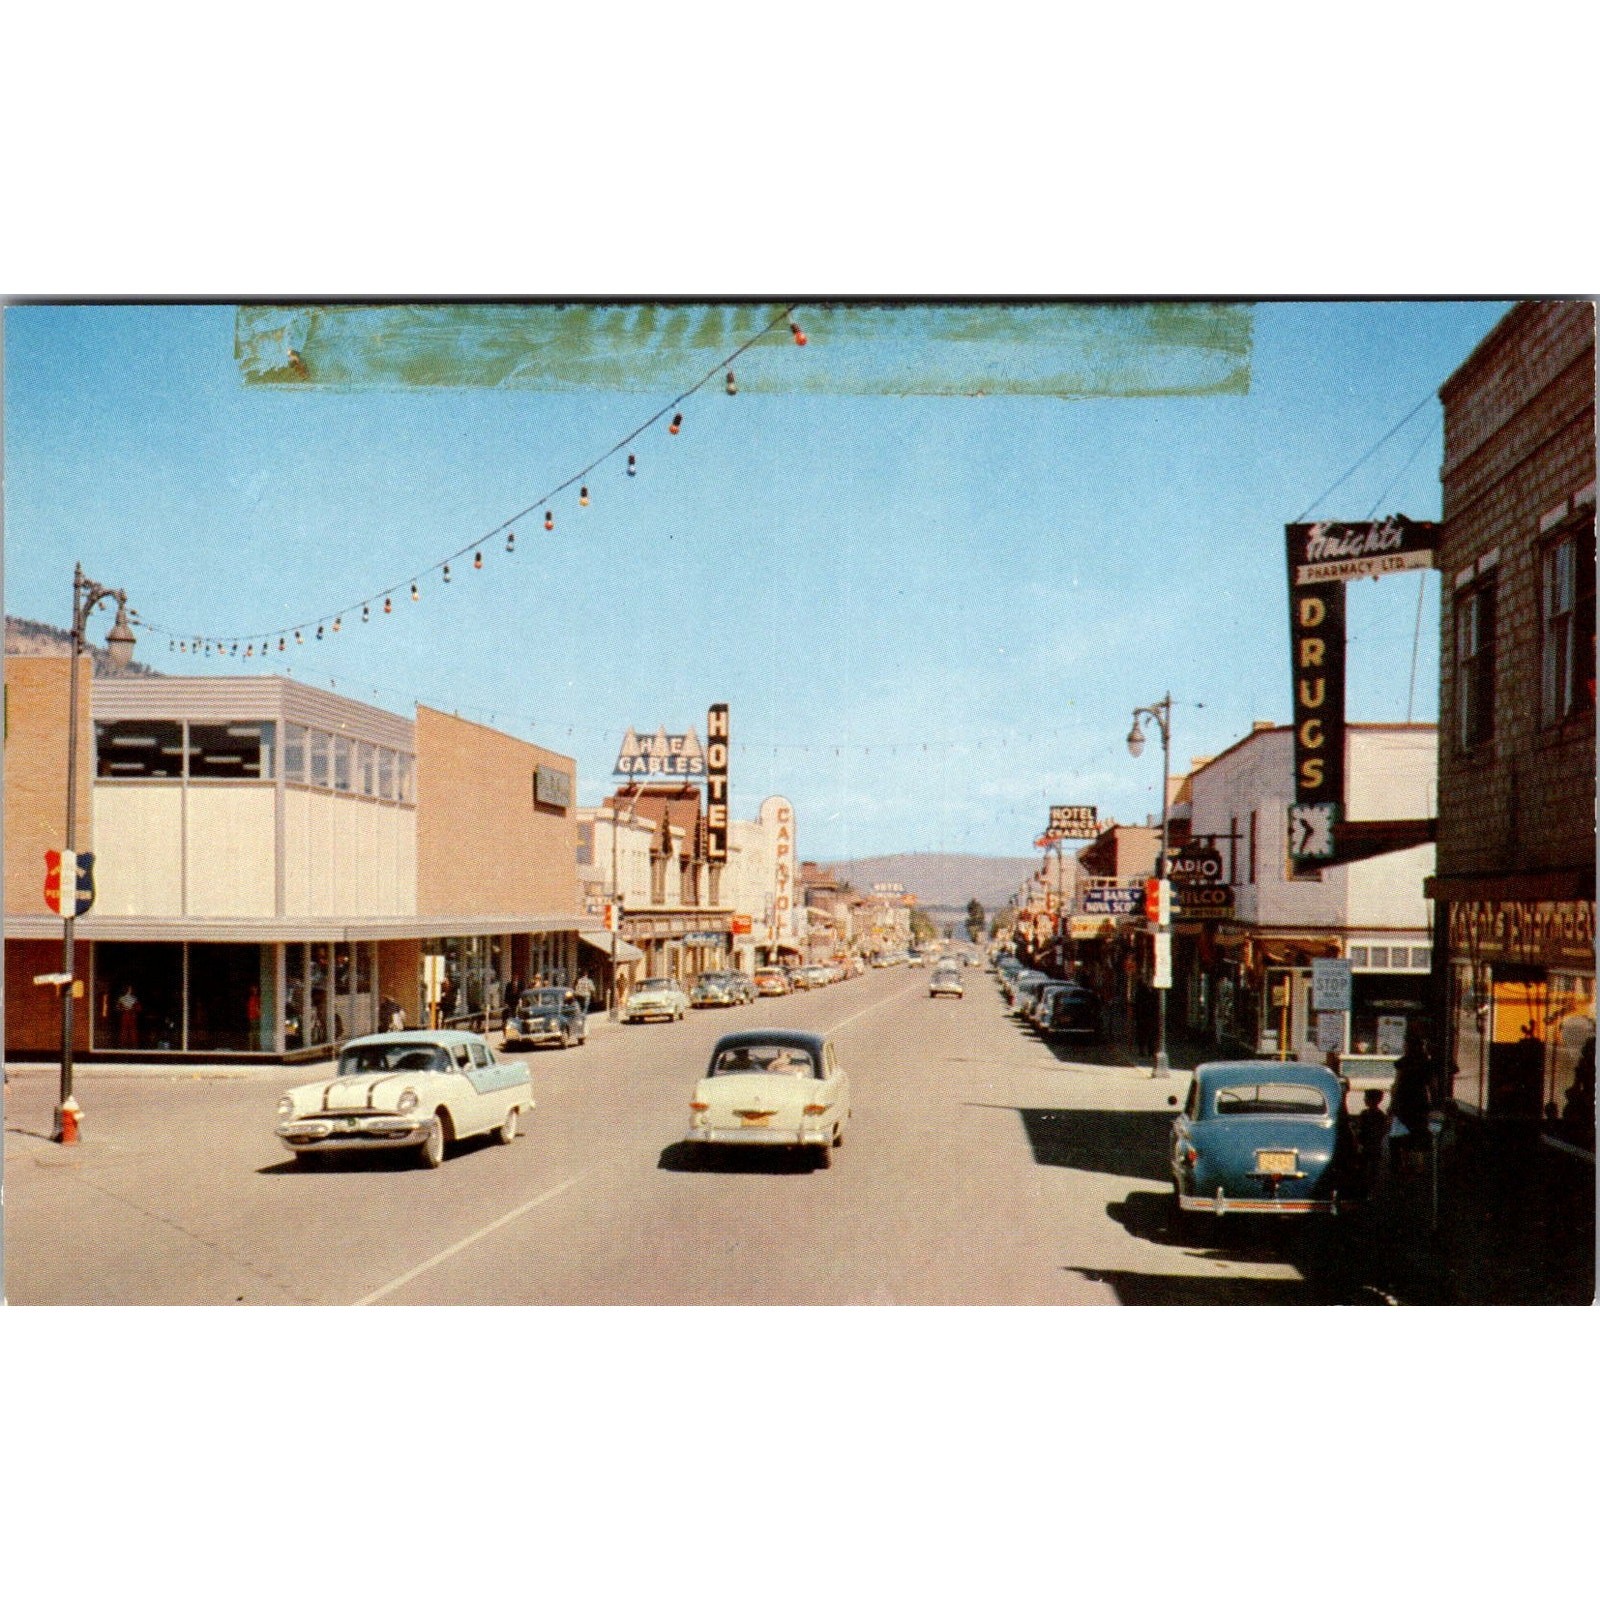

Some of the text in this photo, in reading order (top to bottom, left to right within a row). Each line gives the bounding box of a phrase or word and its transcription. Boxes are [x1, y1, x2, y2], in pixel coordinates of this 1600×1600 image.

[1308, 561, 1374, 578] PHARMACY
[618, 757, 703, 774] GABLES
[709, 711, 728, 856] HOTEL
[1317, 979, 1347, 991] STOP
